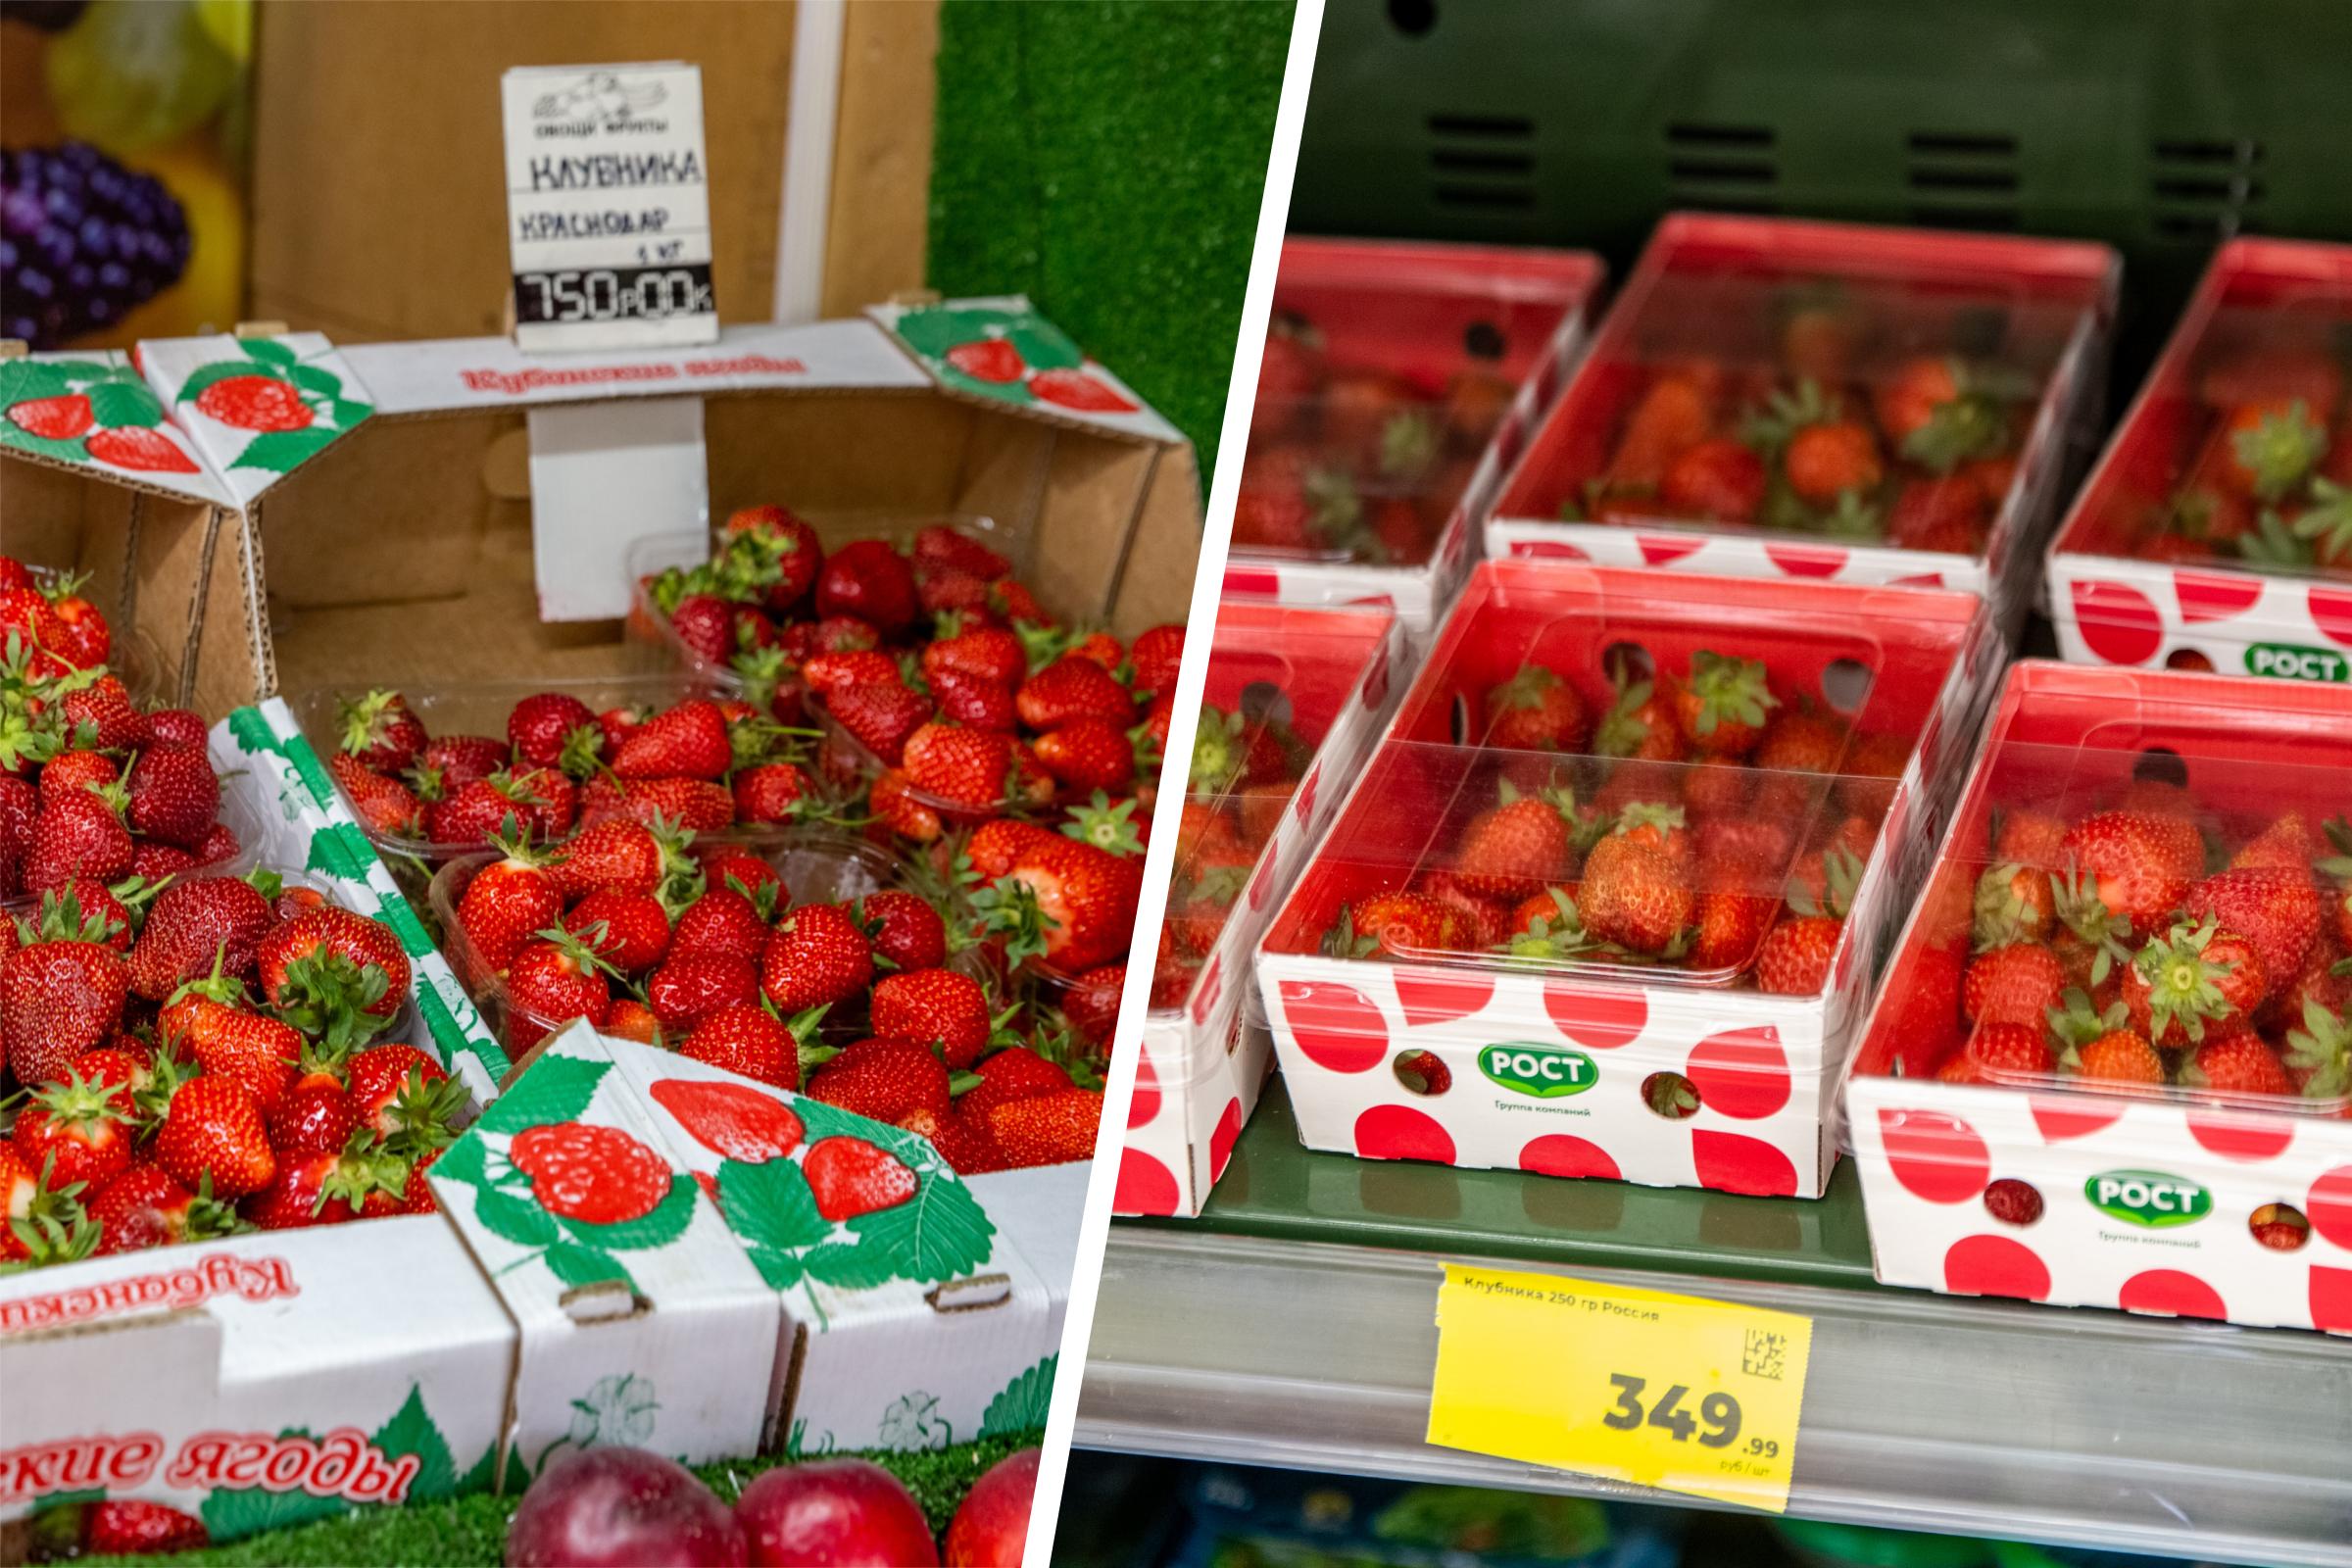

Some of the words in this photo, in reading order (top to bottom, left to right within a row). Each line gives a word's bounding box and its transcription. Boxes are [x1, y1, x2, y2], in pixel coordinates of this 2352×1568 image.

[534, 122, 597, 139] ОВОЩИ
[606, 119, 668, 136] ФРУКТЫ
[530, 149, 703, 192] КЛУБНИКА
[518, 207, 669, 241] КРАСНОДАР
[2254, 648, 2340, 680] РОСТ
[1491, 1051, 1586, 1082] РОСТ
[1494, 1100, 1533, 1112] Группа
[1535, 1104, 1592, 1117] компаний
[2097, 1178, 2199, 1213] РОСТ
[2099, 1230, 2139, 1243] Группа
[1463, 1275, 1545, 1302] Клубника
[1548, 1291, 1577, 1307] 250
[1581, 1298, 1598, 1313] гр
[1602, 1300, 1661, 1323] Россия
[166, 1425, 420, 1504] ягоды
